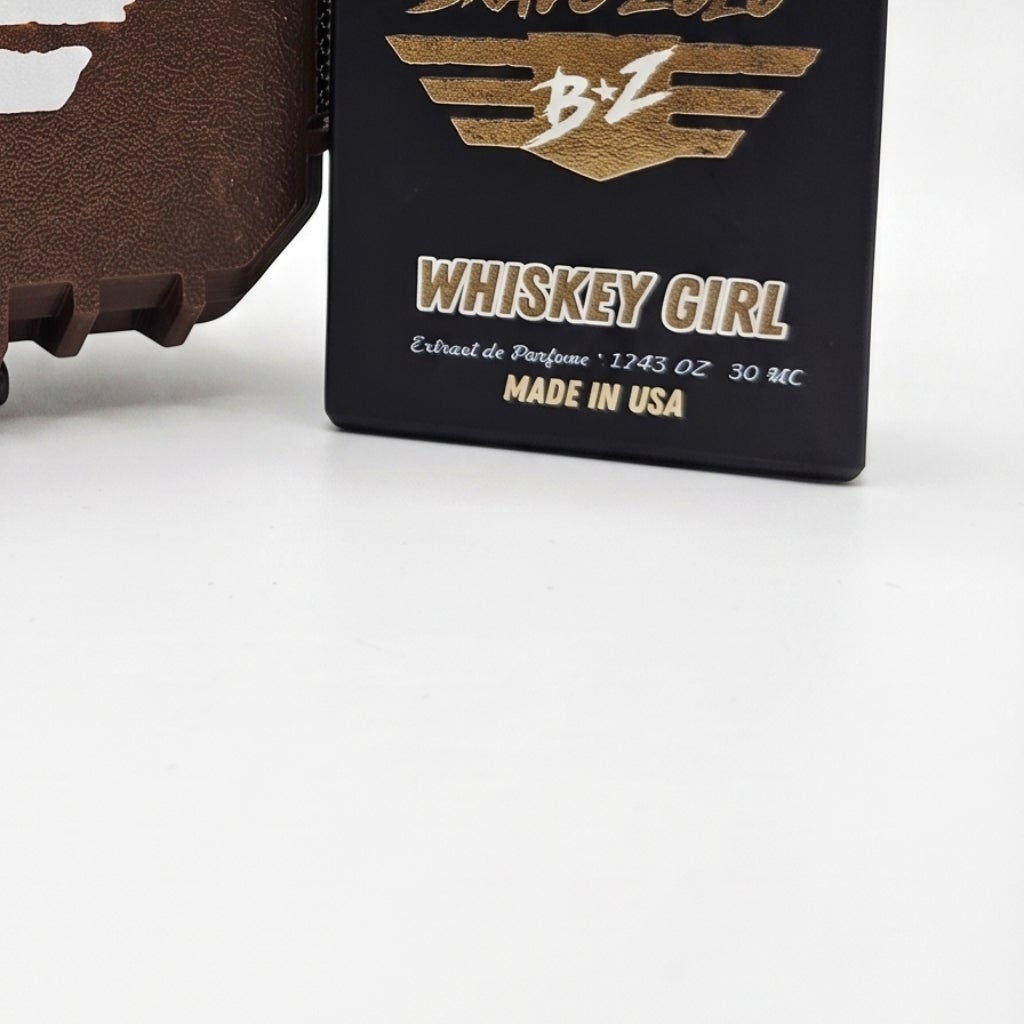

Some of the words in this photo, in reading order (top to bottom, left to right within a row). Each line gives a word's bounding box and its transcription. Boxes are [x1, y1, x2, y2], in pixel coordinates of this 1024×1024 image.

[416, 256, 658, 328] WHISKEY
[661, 274, 791, 340] GIRL
[482, 342, 505, 360] de
[728, 363, 760, 381] 30
[503, 374, 579, 407] MADE
[587, 382, 621, 411] IN
[628, 386, 685, 418] USA
